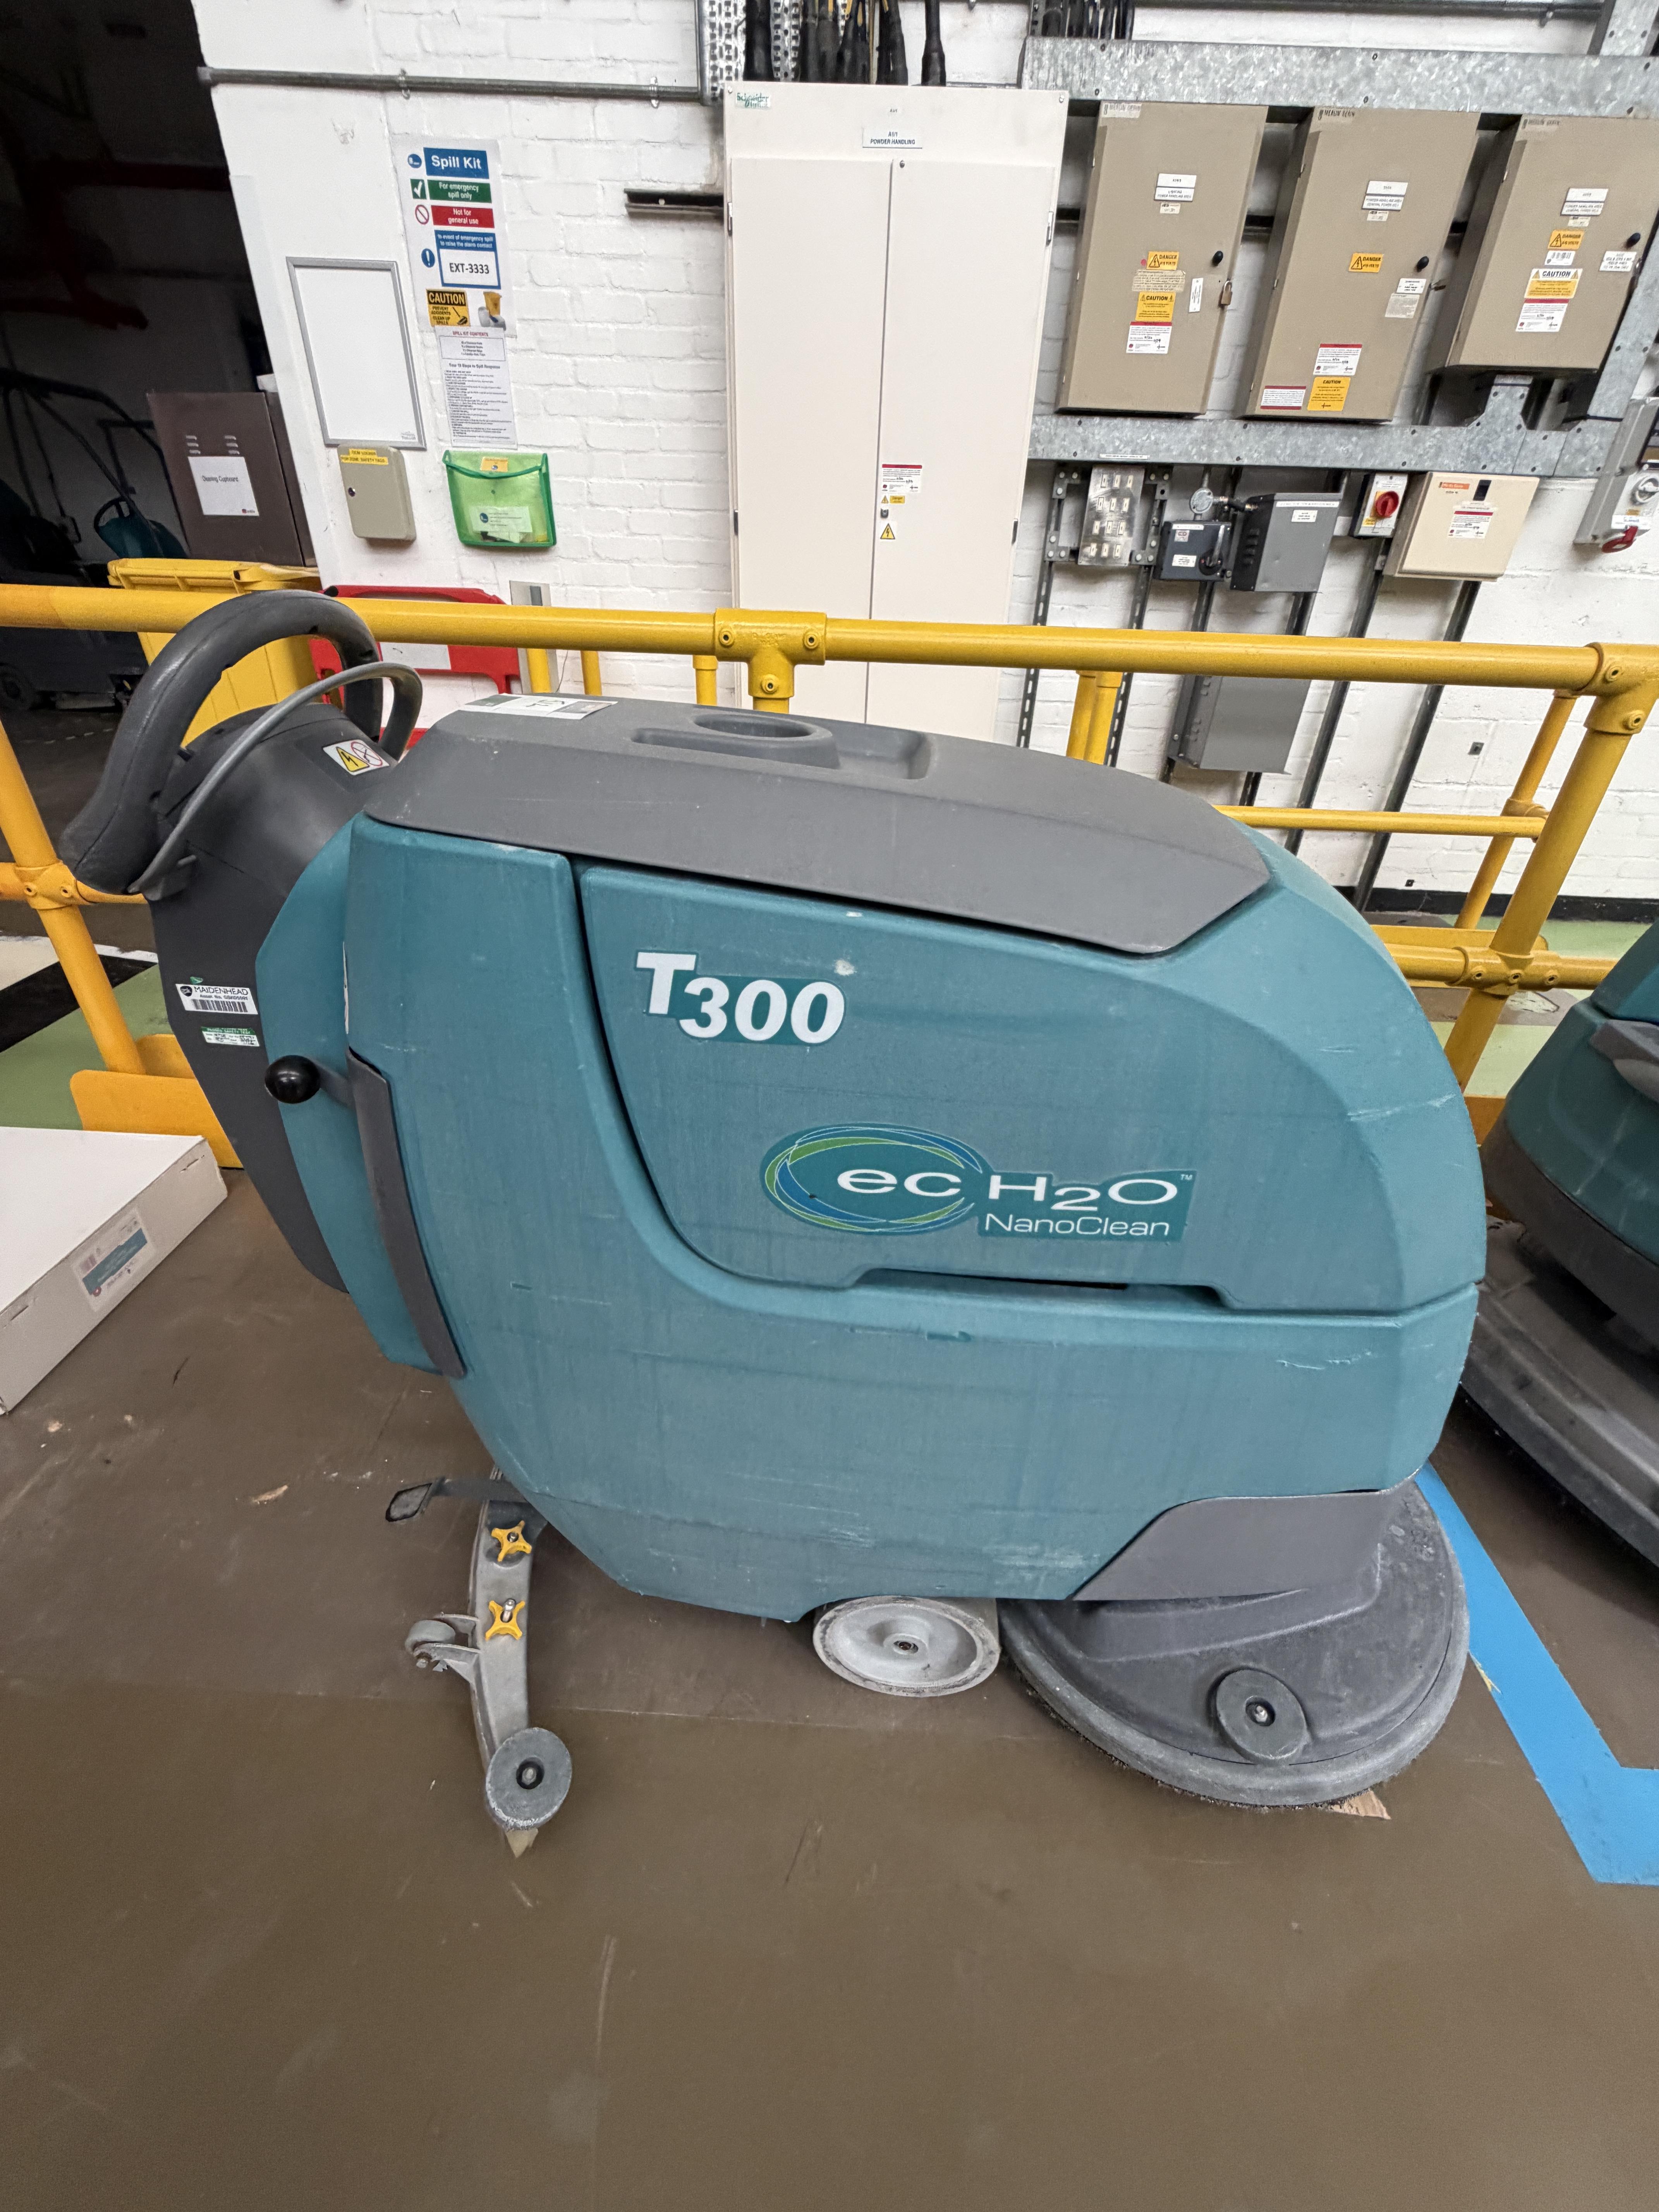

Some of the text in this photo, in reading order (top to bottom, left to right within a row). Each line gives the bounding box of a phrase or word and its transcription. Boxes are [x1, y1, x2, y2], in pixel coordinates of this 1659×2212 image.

[431, 156, 482, 170] Spill Kit
[449, 184, 479, 192] emergency
[448, 191, 472, 201] spill only
[449, 263, 489, 274] EXT-3333
[428, 292, 465, 305] CAUTION
[194, 986, 249, 996] MAIDENHEAD
[636, 952, 845, 1044] T300
[837, 1169, 962, 1197] ec
[985, 1212, 1170, 1237] NanoClean
